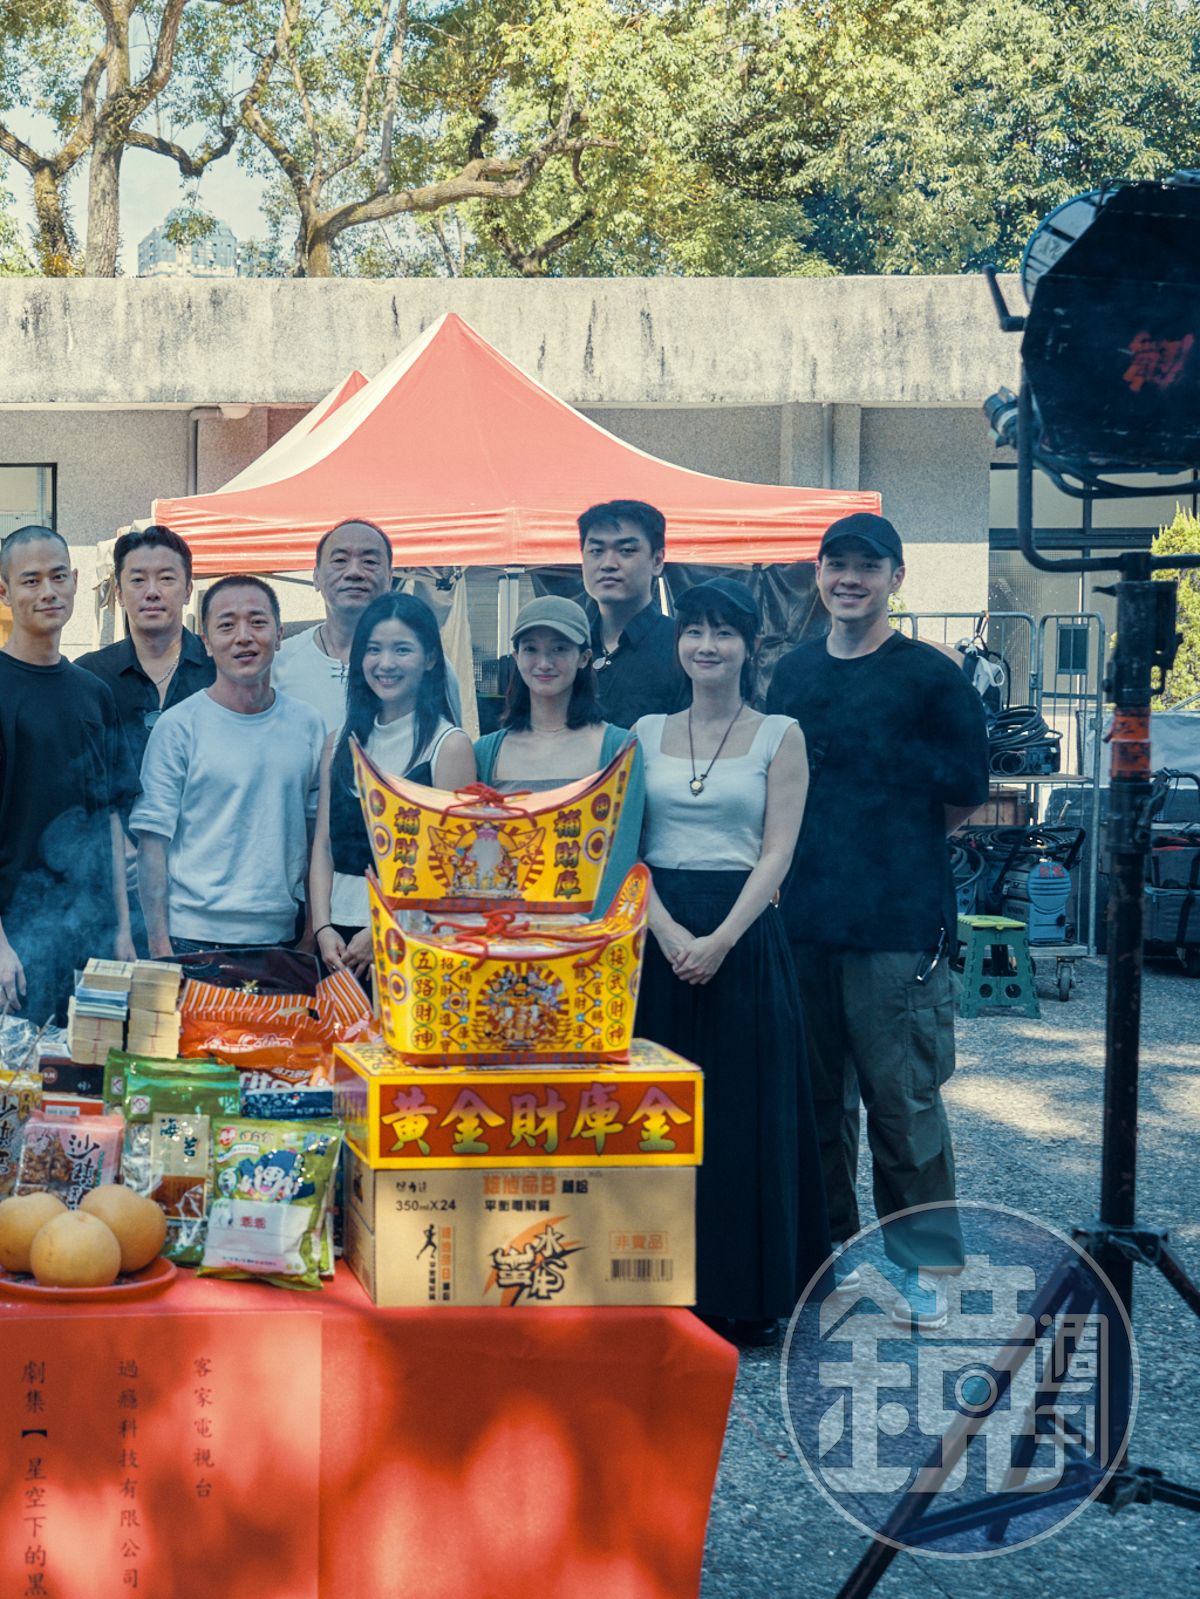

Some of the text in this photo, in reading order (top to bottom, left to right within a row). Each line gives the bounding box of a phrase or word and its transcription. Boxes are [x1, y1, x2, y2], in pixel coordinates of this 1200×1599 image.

[393, 807, 420, 896] 補財庫
[553, 808, 582, 899] 補財庫
[414, 951, 435, 1046] 五路財神
[591, 961, 604, 1051] 官賜福
[615, 1236, 663, 1249] 非賣品
[193, 1357, 216, 1499] 客家電視台
